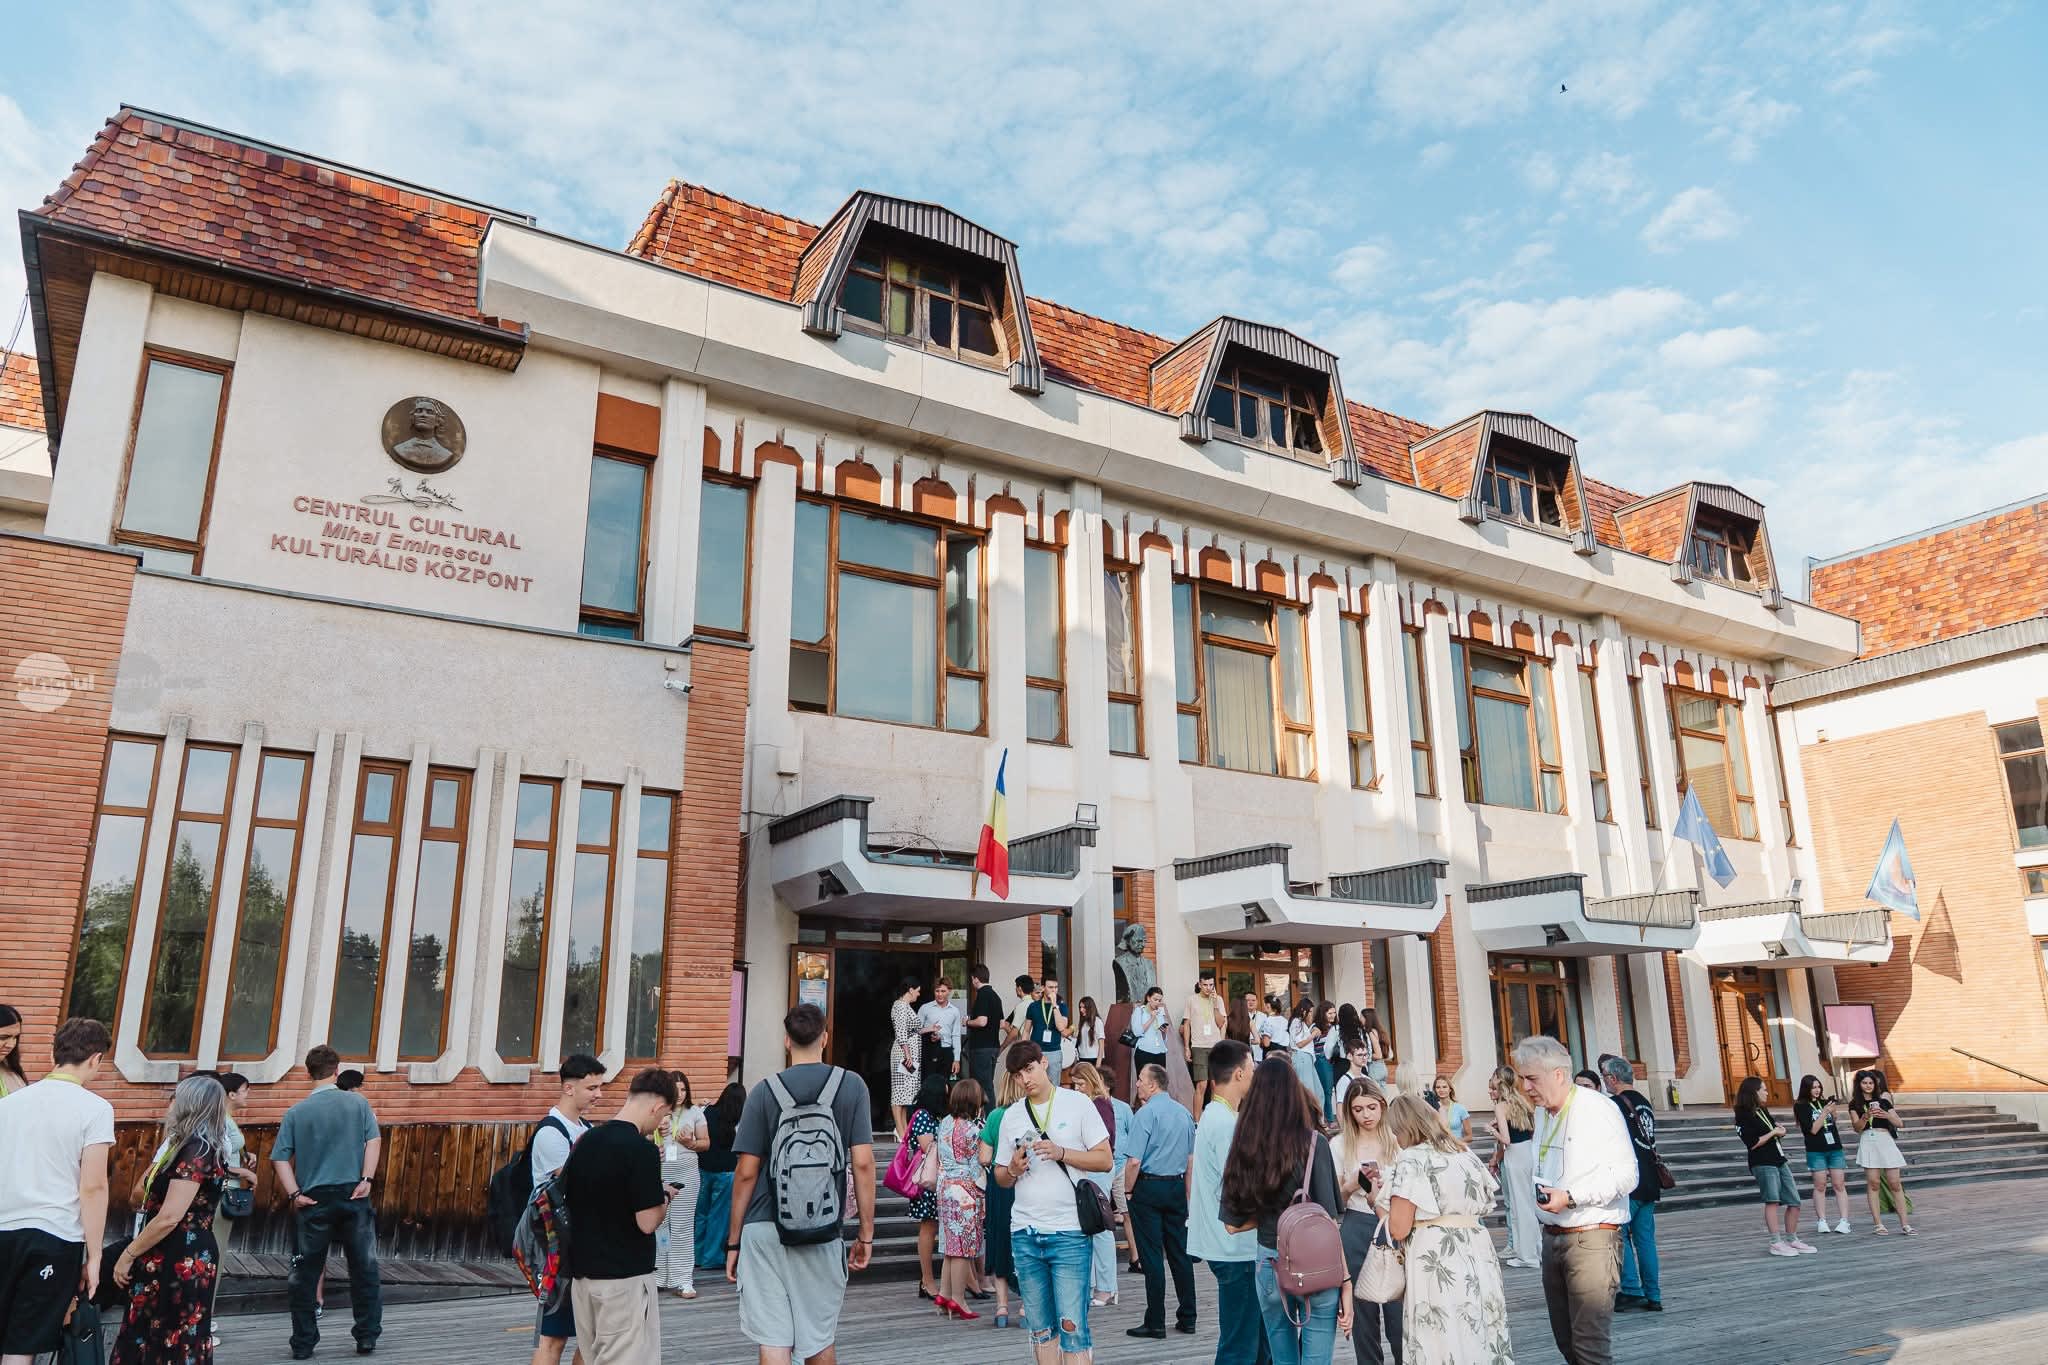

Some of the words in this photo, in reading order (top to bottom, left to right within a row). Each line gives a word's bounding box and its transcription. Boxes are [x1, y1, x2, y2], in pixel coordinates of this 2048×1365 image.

[293, 495, 401, 530] CENTRUL
[409, 515, 521, 550] CULTURAL
[321, 520, 381, 546] Mihai
[386, 531, 493, 566] Eminescu
[271, 533, 418, 574] KULTURÁLIS
[424, 560, 534, 593] KÖZPONT
